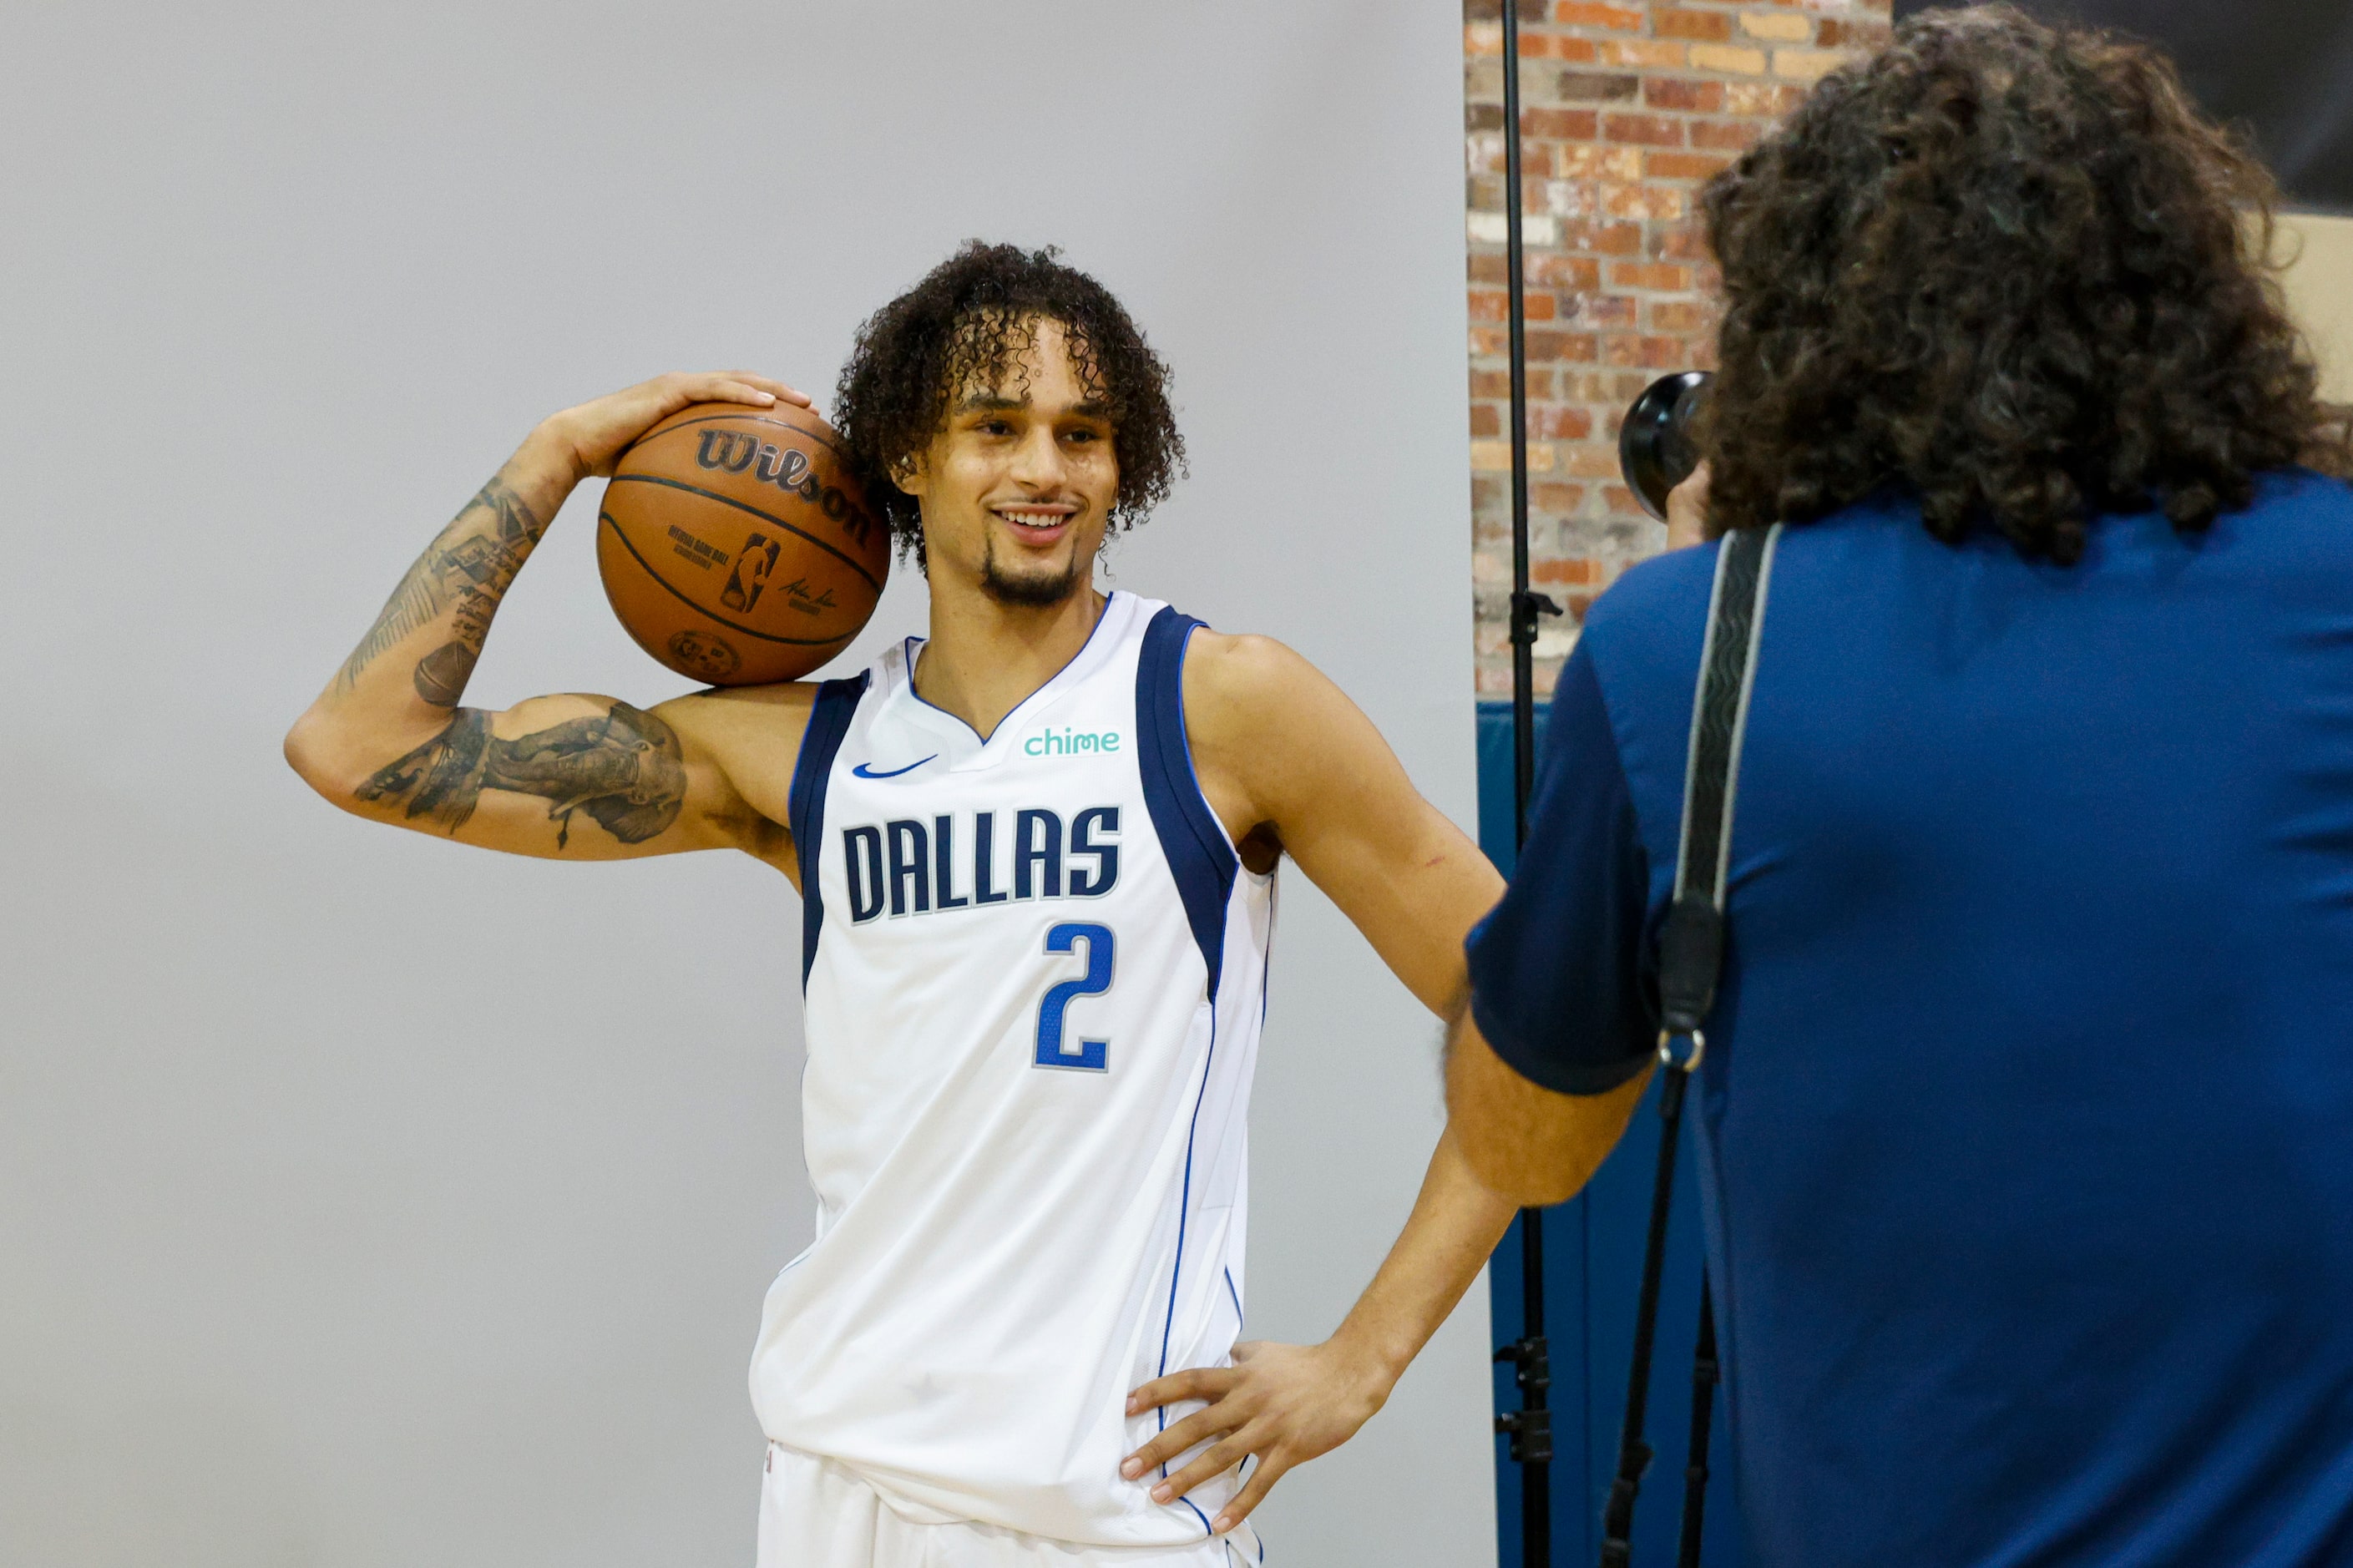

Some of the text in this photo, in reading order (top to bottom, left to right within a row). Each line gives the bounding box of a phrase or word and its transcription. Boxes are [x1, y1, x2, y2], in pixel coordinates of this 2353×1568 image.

[696, 429, 872, 551] Wilson
[711, 549, 730, 566] BALL
[1025, 727, 1120, 756] chime
[841, 803, 1123, 927] DALLAS
[1031, 919, 1117, 1074] 2
